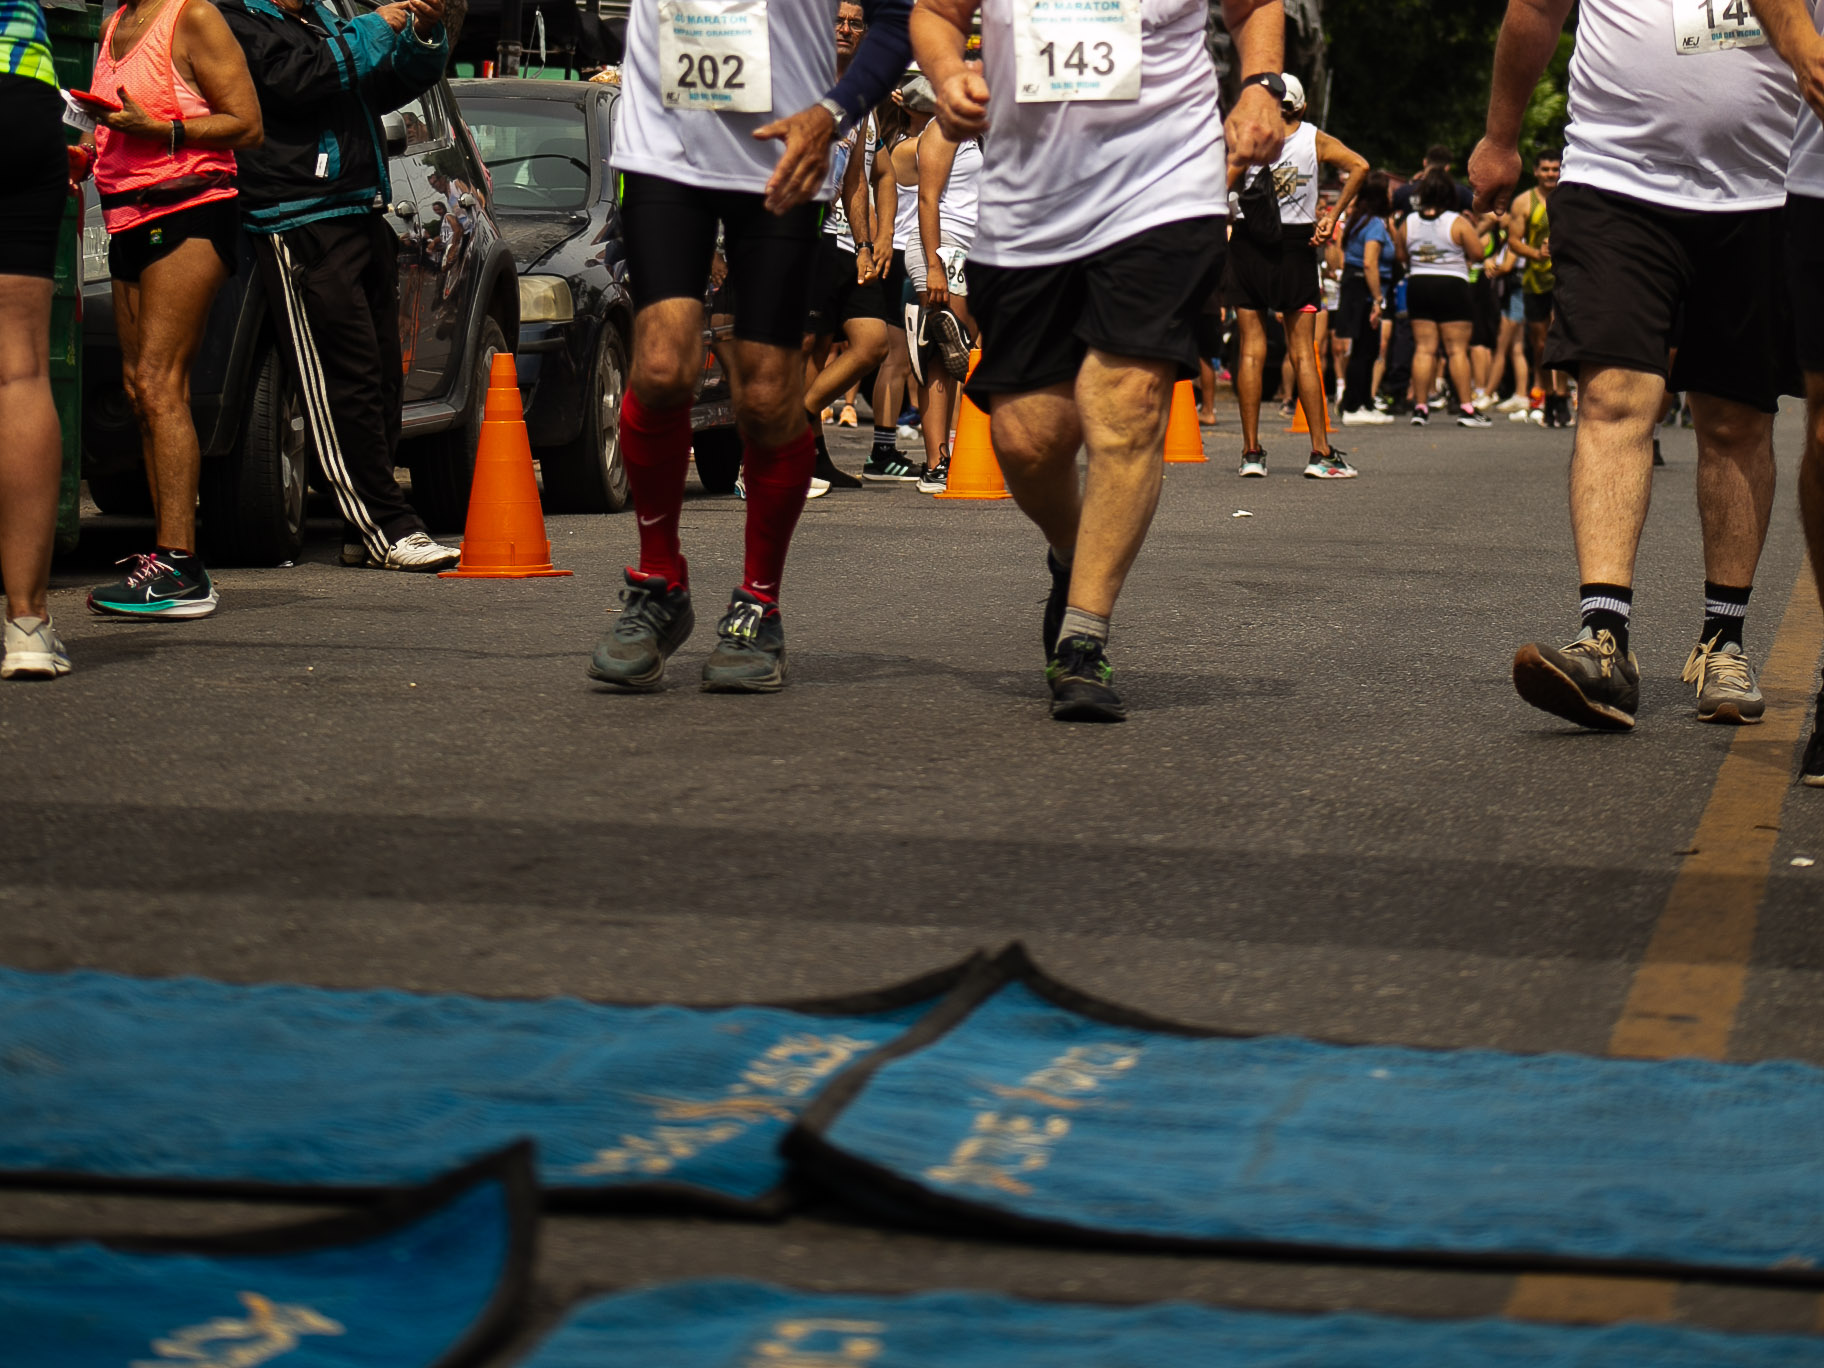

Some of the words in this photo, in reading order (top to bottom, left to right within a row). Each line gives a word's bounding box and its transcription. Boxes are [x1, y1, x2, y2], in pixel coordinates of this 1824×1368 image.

[1054, 0, 1121, 12] MARATON
[1682, 36, 1700, 47] NEJ
[1039, 40, 1116, 78] 143
[677, 53, 746, 90] 202
